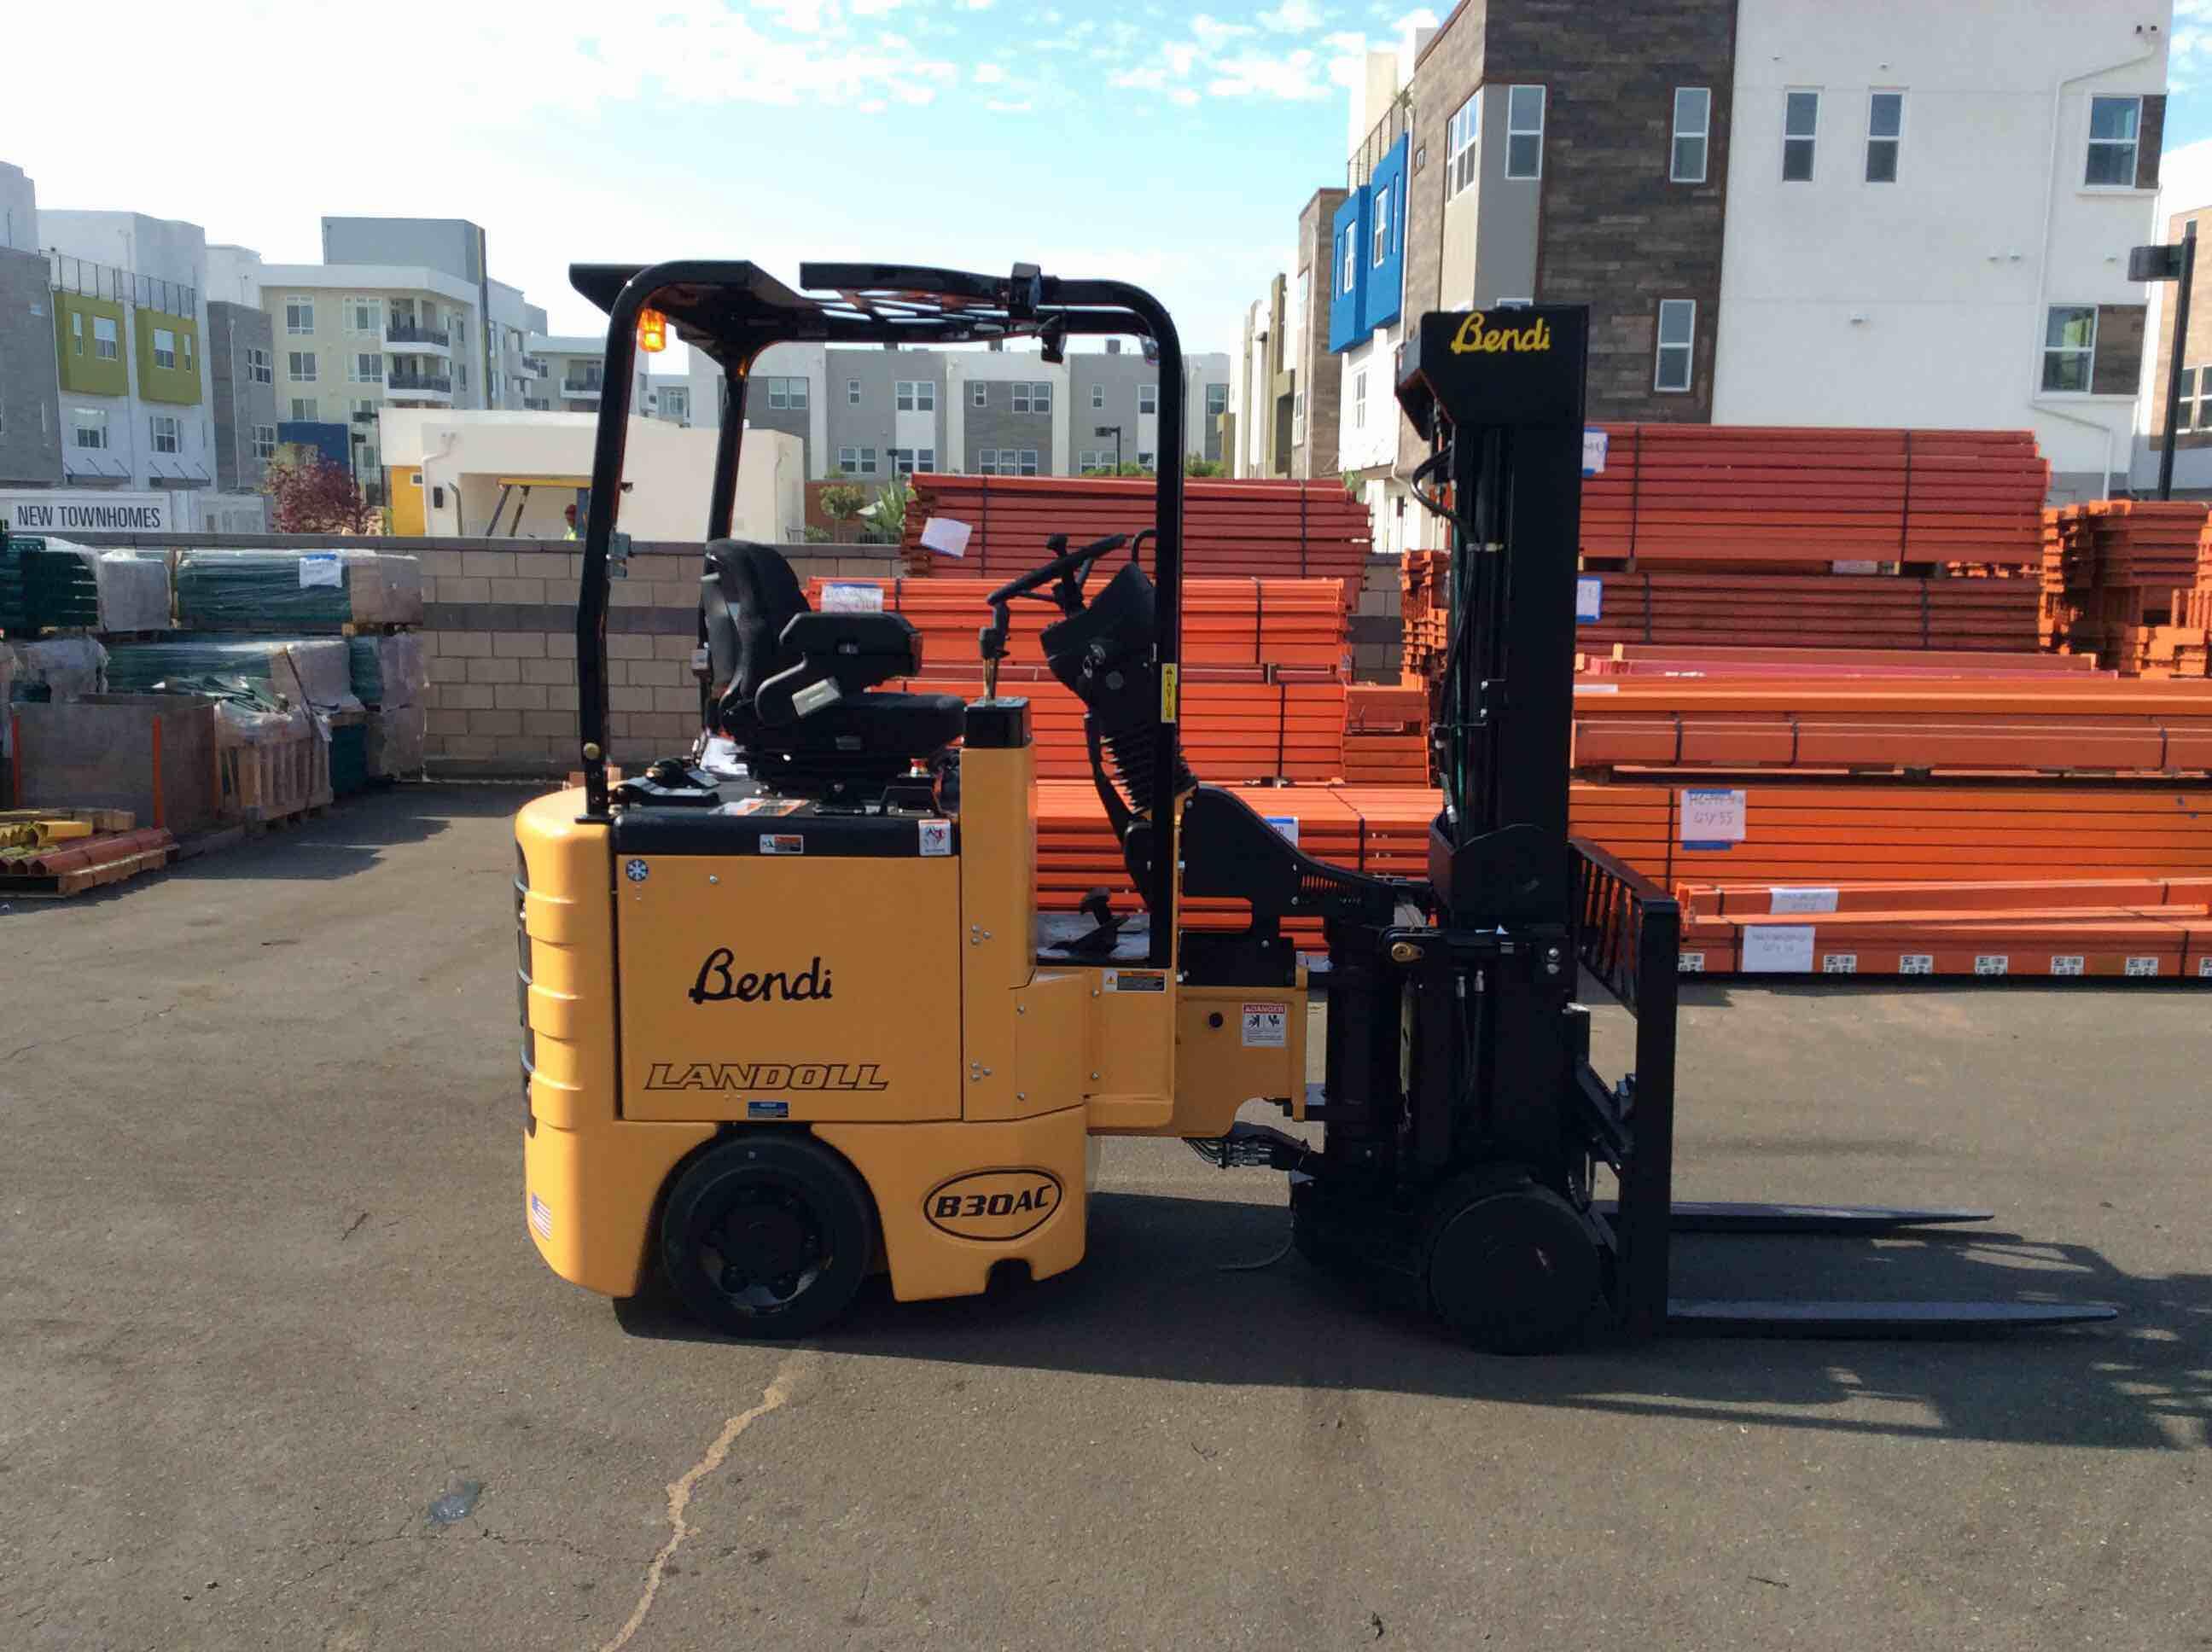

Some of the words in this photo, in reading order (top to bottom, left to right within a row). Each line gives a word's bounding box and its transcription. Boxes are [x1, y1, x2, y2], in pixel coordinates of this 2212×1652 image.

[1450, 311, 1551, 355] Bendi
[17, 505, 53, 526] NEW
[58, 506, 160, 528] TOWNHOMES
[688, 947, 833, 1004] Bendi
[643, 1063, 889, 1091] LANDOLL
[934, 1184, 1051, 1219] B30AC
